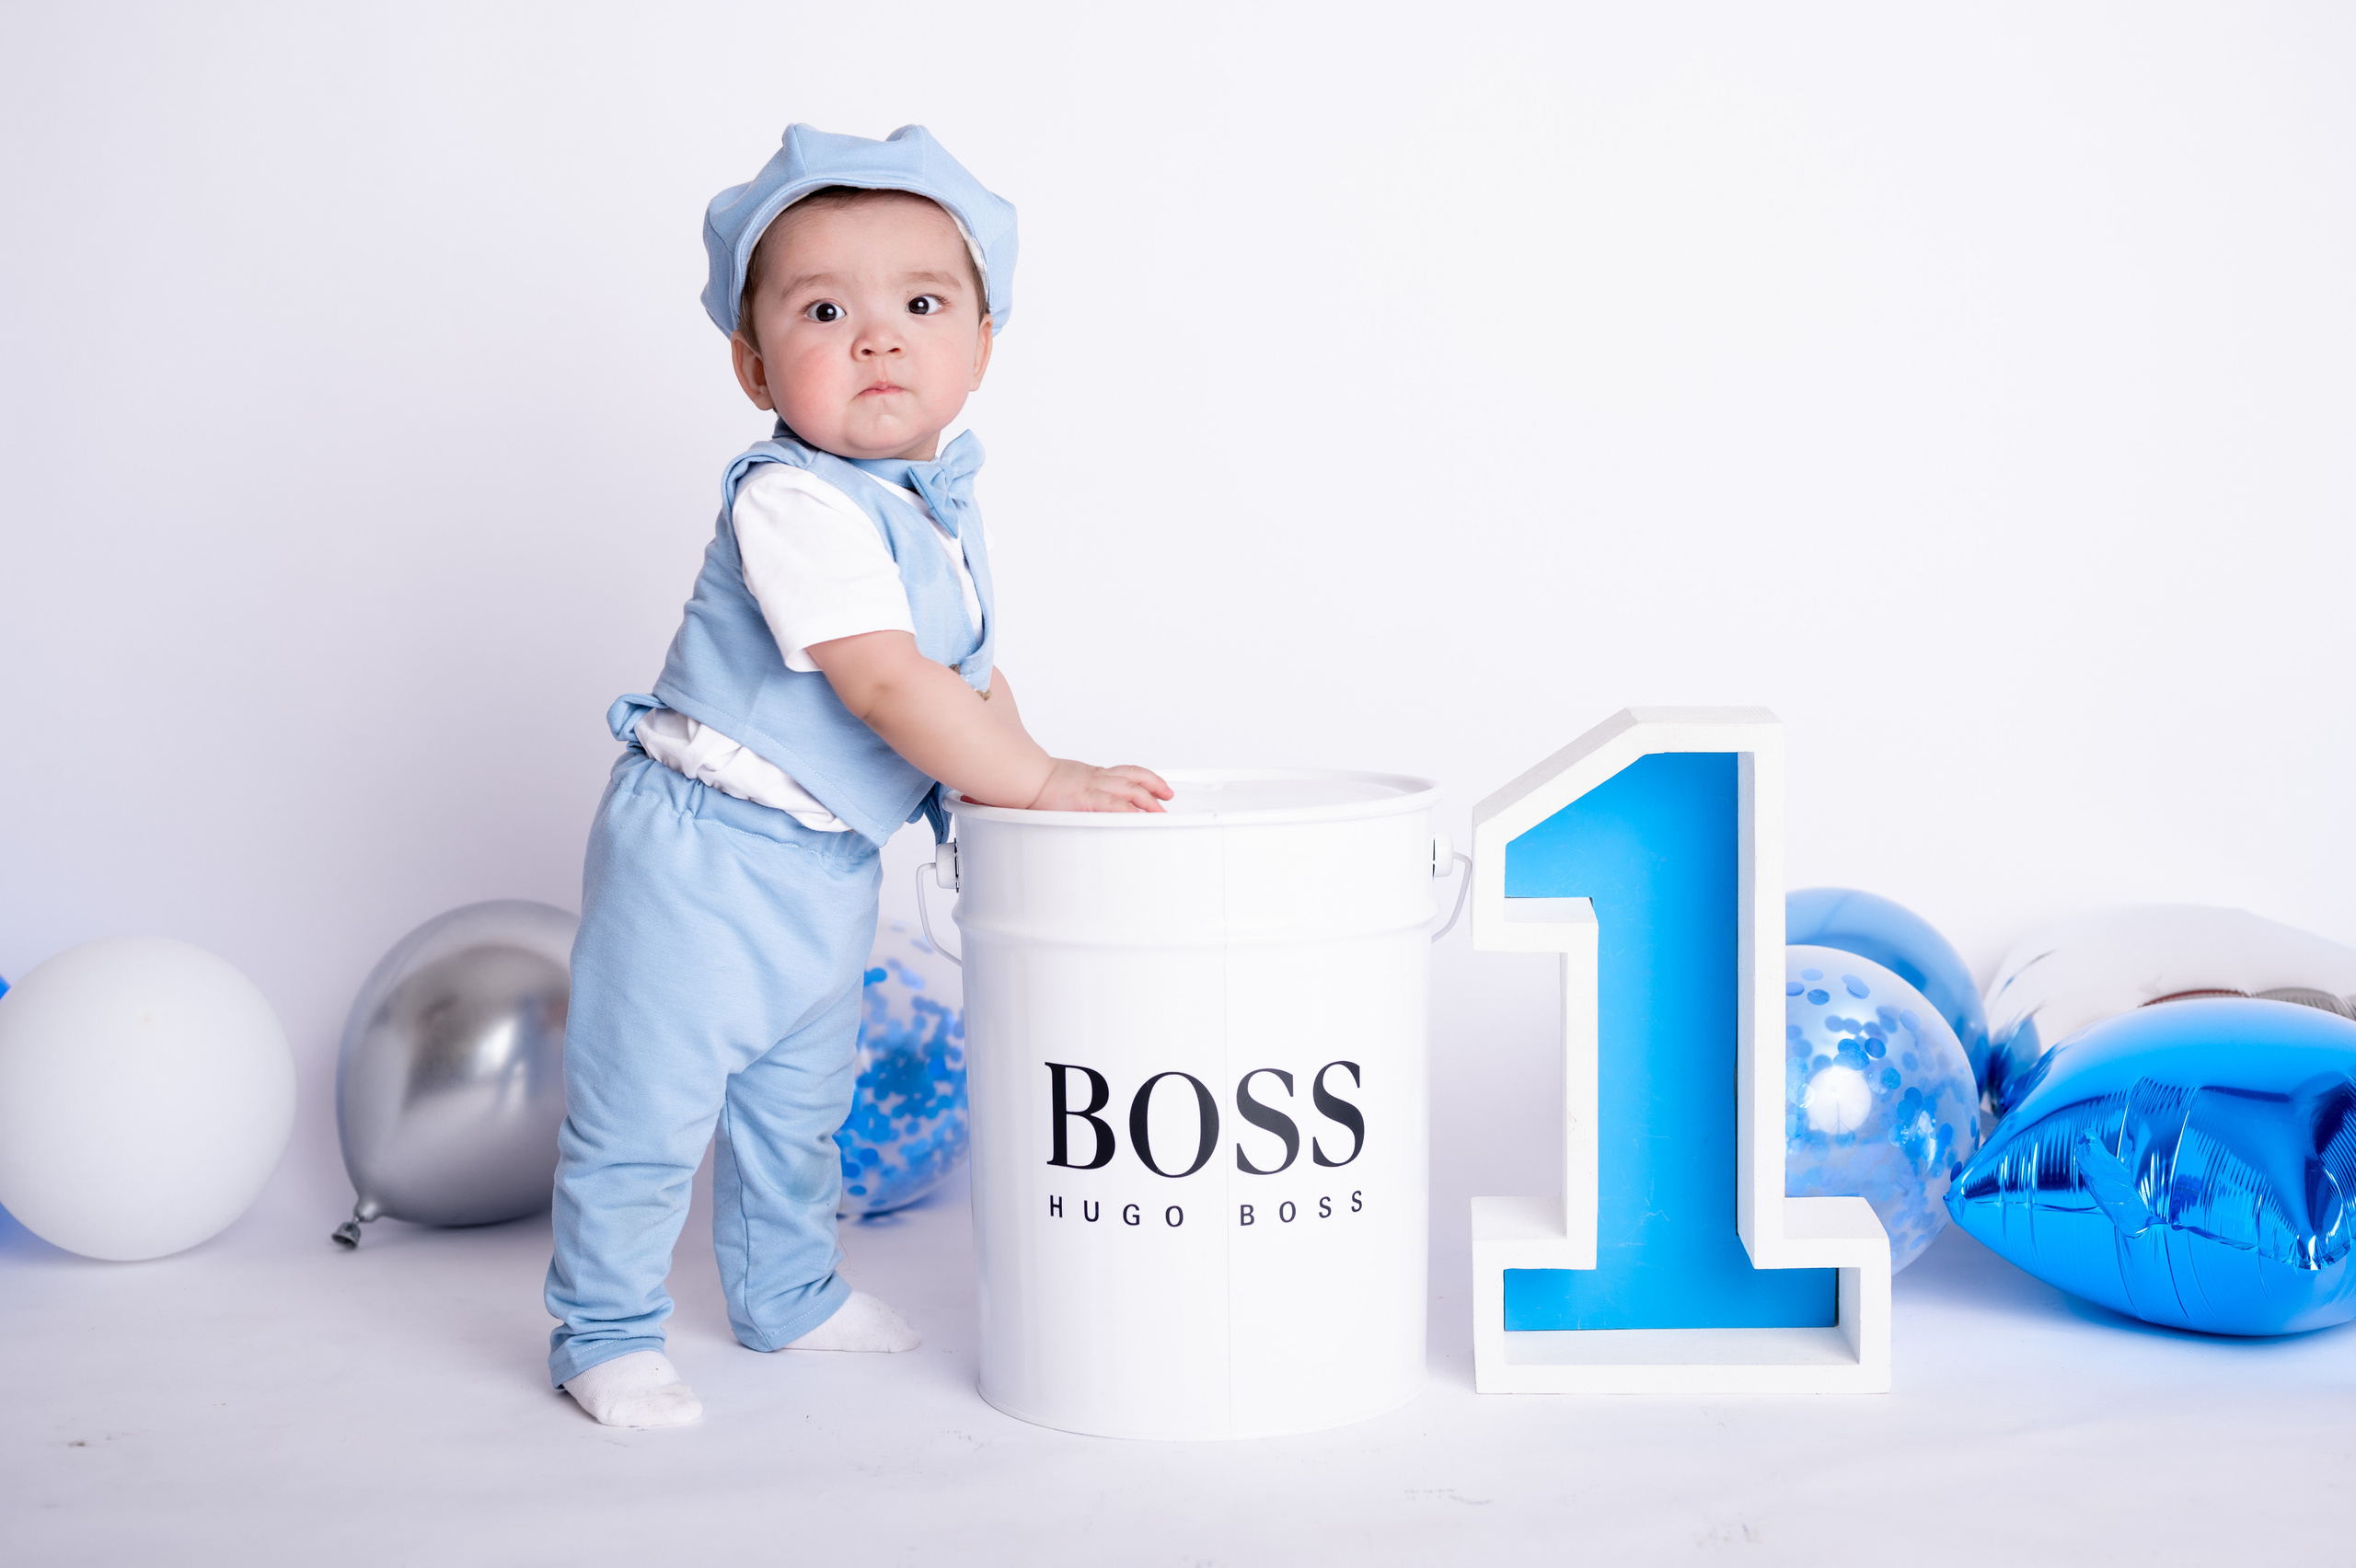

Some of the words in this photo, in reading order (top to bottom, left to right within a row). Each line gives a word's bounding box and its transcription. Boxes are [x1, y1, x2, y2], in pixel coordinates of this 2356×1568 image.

[1472, 707, 1892, 1396] 1
[1044, 1060, 1365, 1179] BOSS
[1049, 1194, 1184, 1228] HUGO
[1240, 1190, 1364, 1228] BOSS
